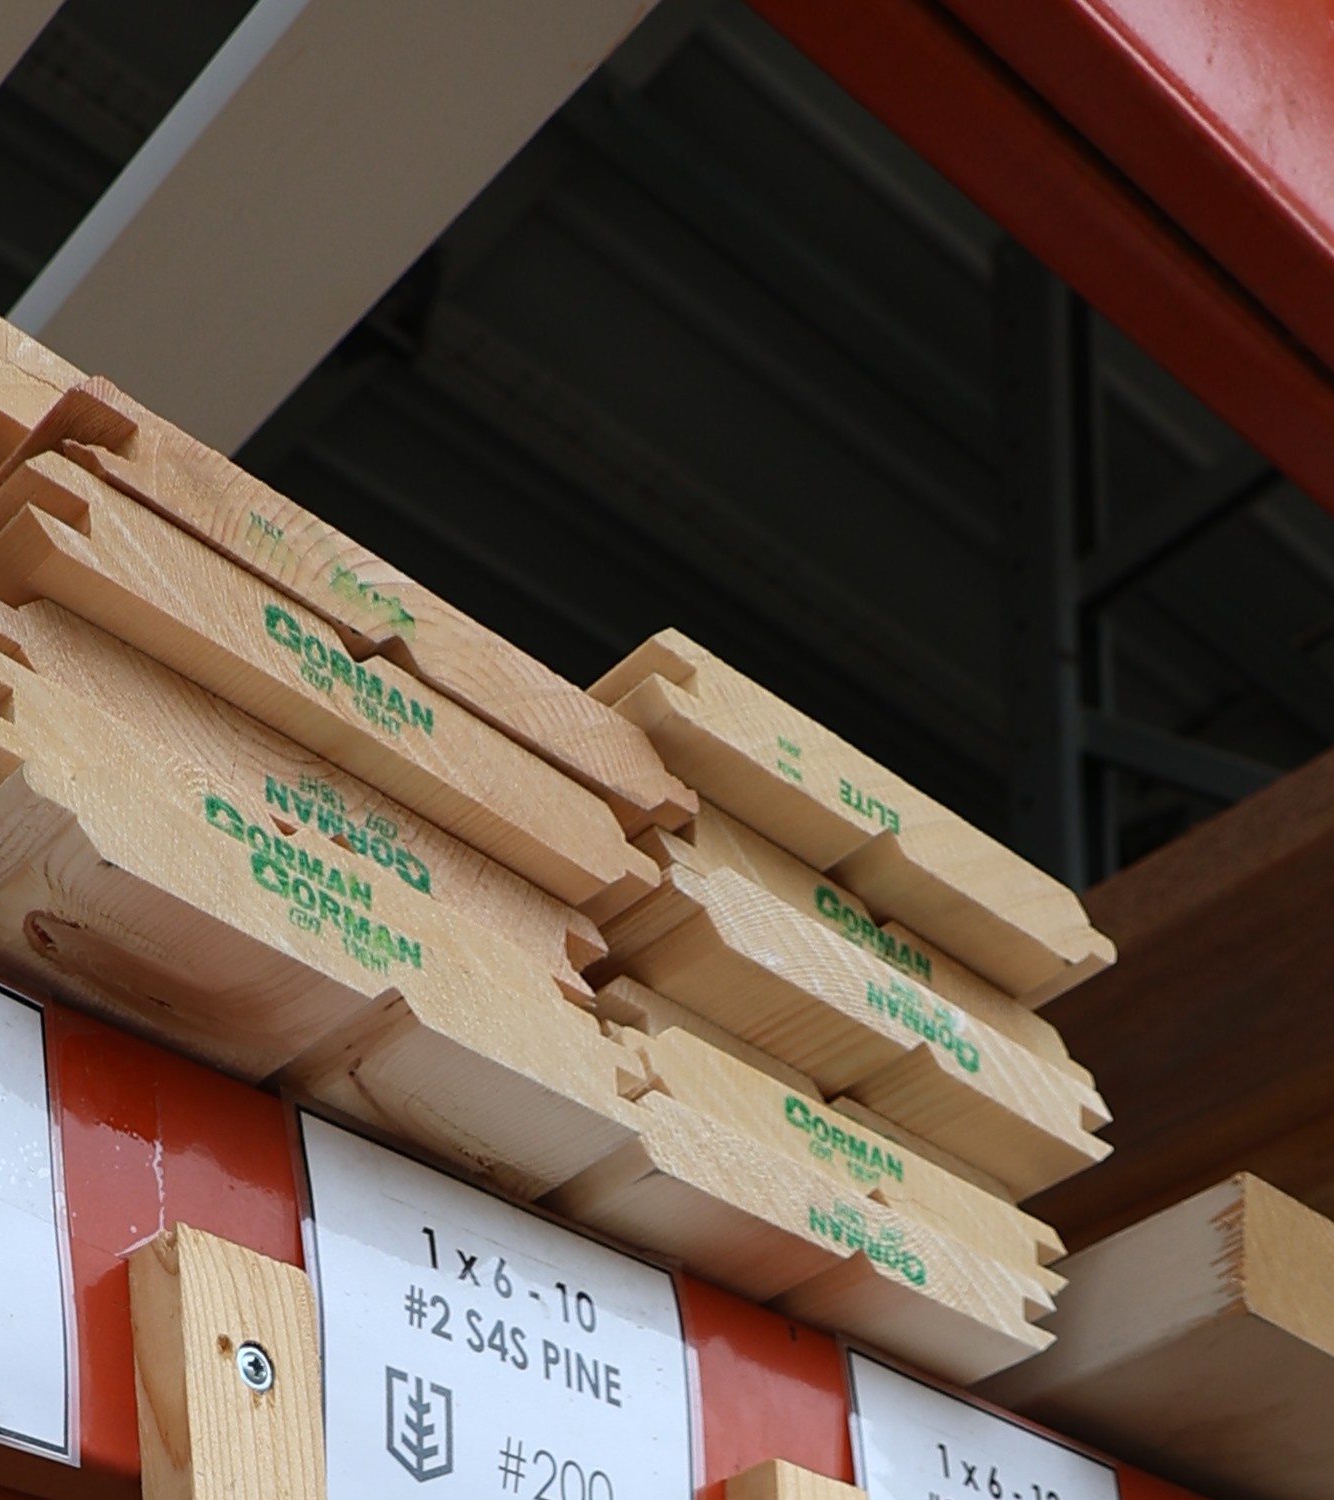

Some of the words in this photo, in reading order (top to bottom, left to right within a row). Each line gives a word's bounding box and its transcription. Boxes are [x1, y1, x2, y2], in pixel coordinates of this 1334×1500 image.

[264, 602, 436, 738] GORMAN
[204, 793, 374, 909] GORMAN
[264, 775, 433, 897] GORMAN
[250, 851, 423, 971] GORMAN
[815, 884, 932, 984] GORMAN
[866, 979, 981, 1075] GORMAN
[783, 1094, 905, 1184] GORMAN
[421, 1227, 440, 1270] 1
[455, 1249, 482, 1287] x
[492, 1256, 513, 1299] 6
[554, 1282, 598, 1334] 10
[808, 1205, 926, 1287] GORMAN
[404, 1284, 454, 1342] #2
[467, 1308, 529, 1370] S4S
[542, 1339, 623, 1409] PINE
[937, 1443, 951, 1478] 1
[961, 1459, 977, 1492] x
[987, 1466, 1002, 1500] 6
